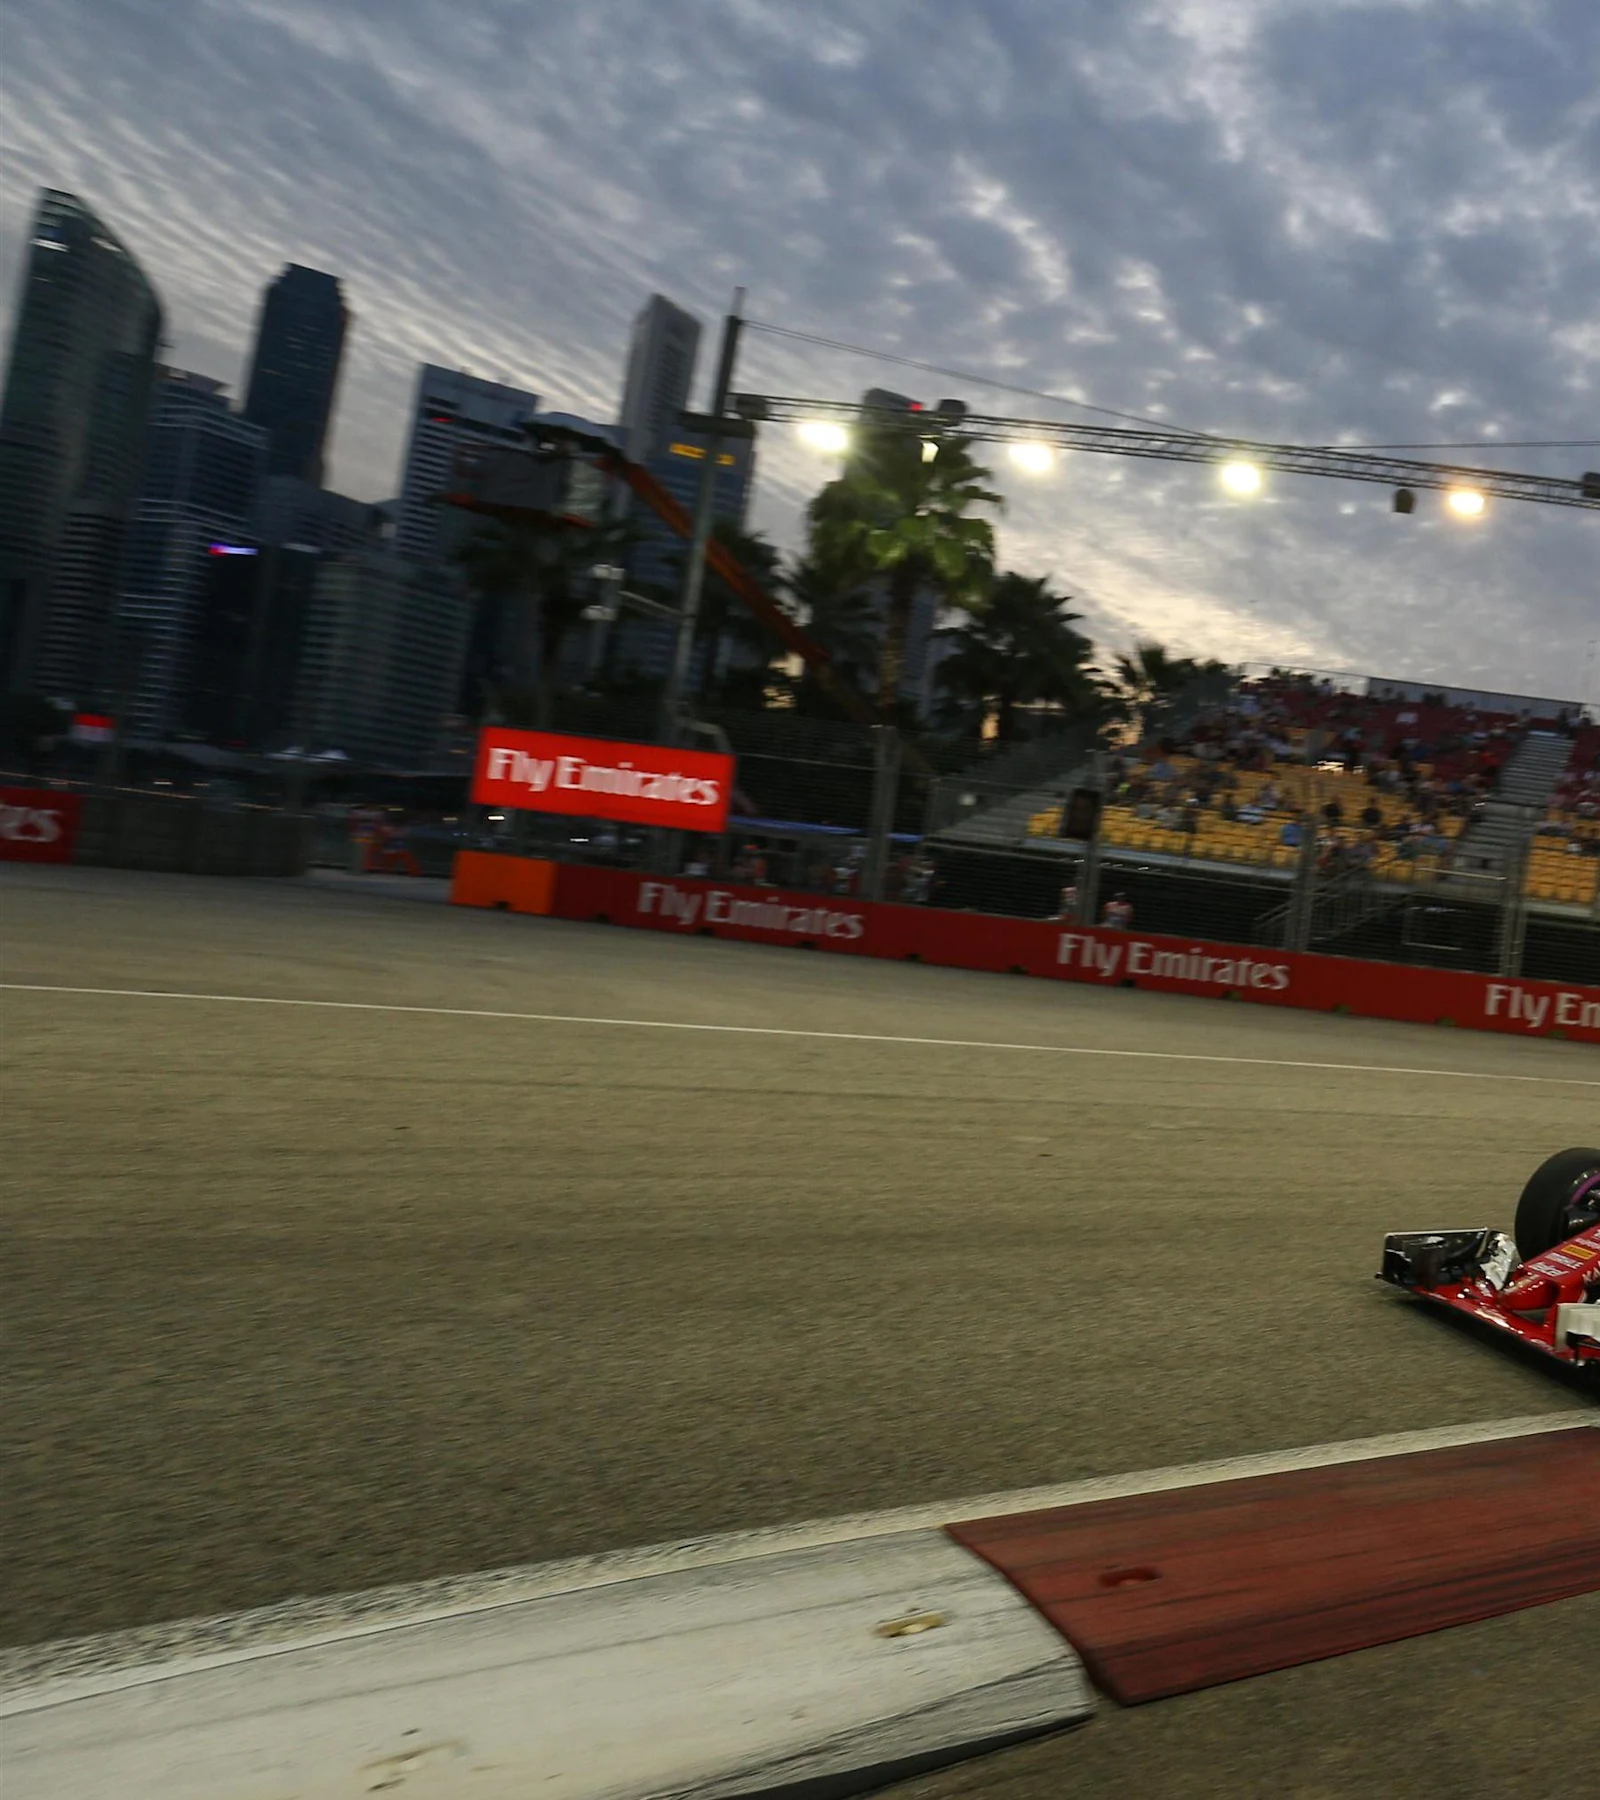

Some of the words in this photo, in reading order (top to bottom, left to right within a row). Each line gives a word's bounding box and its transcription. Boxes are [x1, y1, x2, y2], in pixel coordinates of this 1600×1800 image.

[488, 747, 556, 792] Fly
[557, 755, 720, 806] Emirates
[637, 881, 701, 926] Fly
[706, 889, 865, 940] Emirates
[1057, 932, 1121, 977] Fly
[1126, 941, 1290, 991] Emirates
[1484, 983, 1550, 1028] Fly
